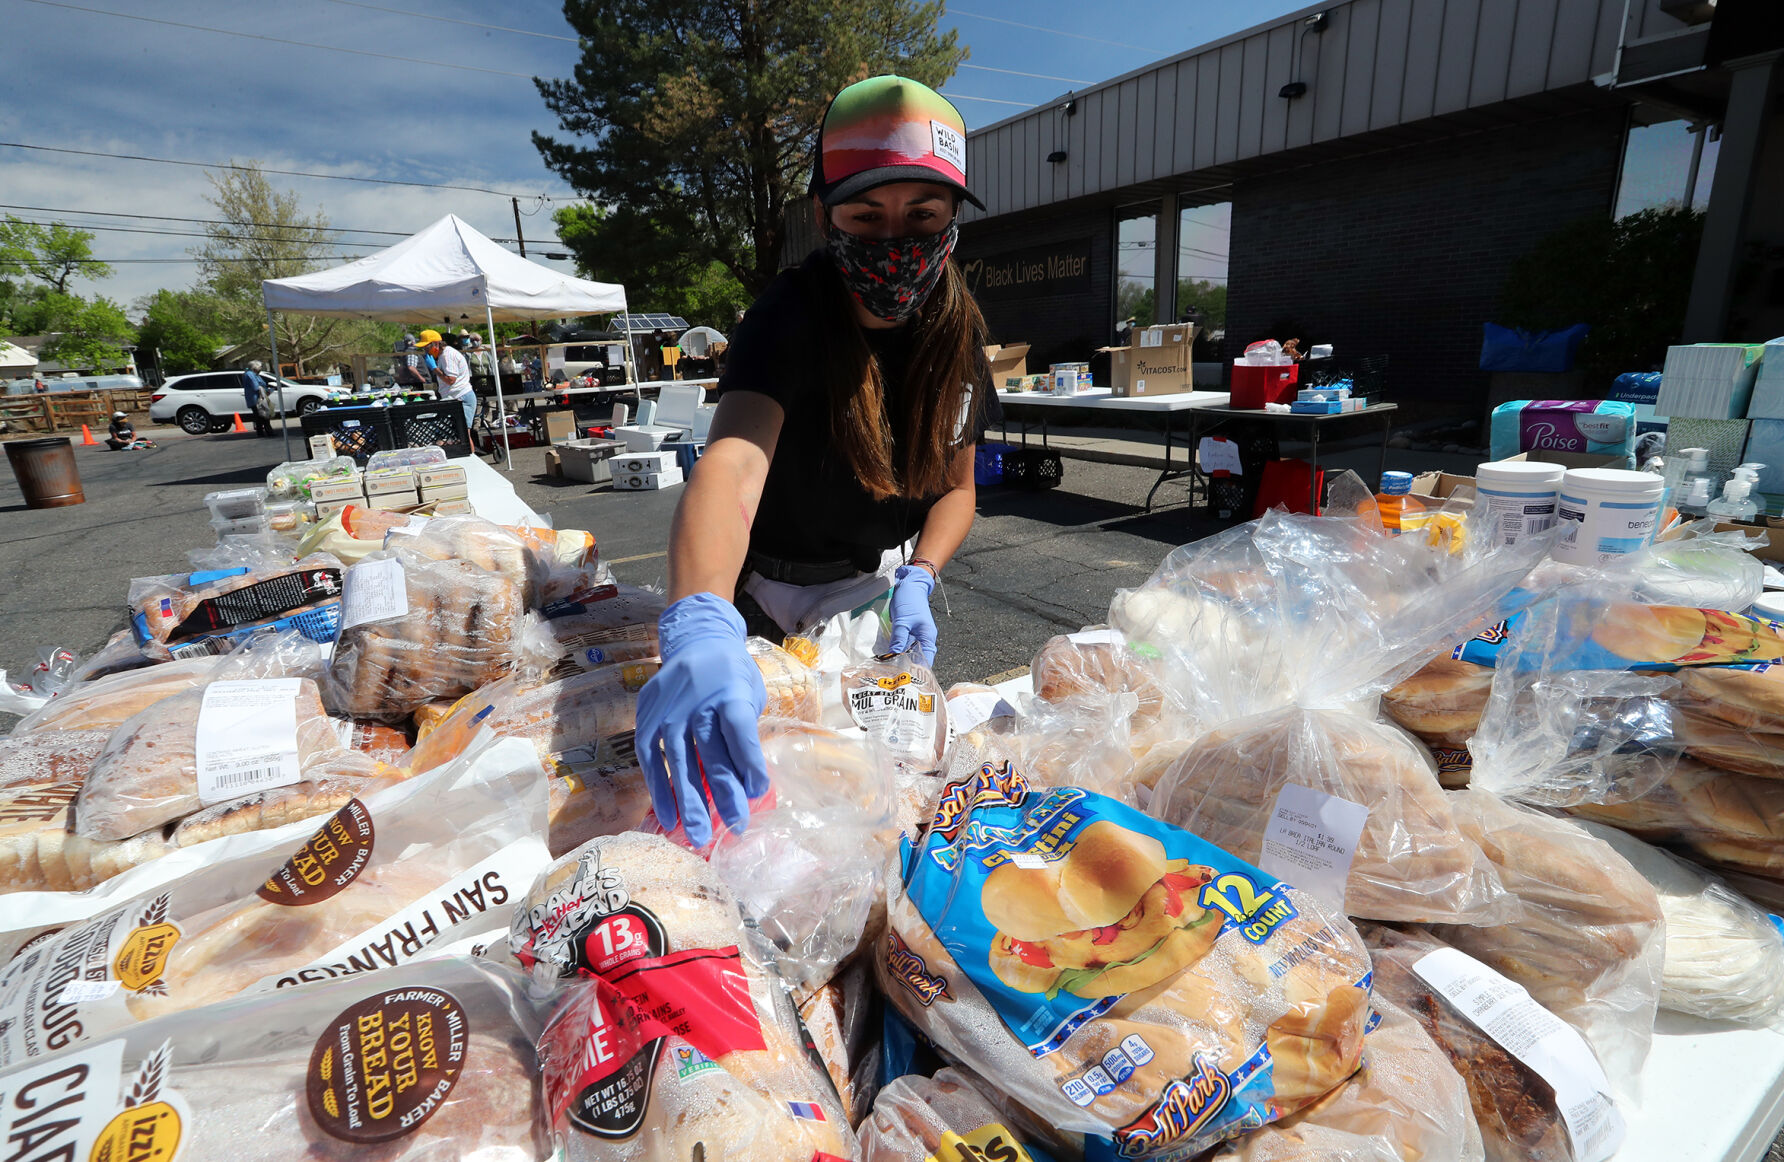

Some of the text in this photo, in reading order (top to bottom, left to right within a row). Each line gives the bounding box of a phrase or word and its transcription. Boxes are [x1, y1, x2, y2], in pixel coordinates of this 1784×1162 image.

[936, 126, 955, 143] WILD
[938, 137, 959, 156] BASIN
[985, 254, 1087, 288] Black Lives Matter
[1526, 422, 1578, 450] Poise
[328, 815, 354, 847] NOW
[334, 802, 372, 886] MILLER BAKER
[1327, 843, 1346, 855] ROUND
[441, 871, 510, 927] SAN
[533, 888, 630, 951] BREAD
[1203, 874, 1275, 924] 12
[1244, 899, 1294, 942] COUNT
[619, 948, 642, 963] GRAINS
[903, 954, 945, 997] Park
[42, 921, 103, 1051] SOURDOUG
[24, 1028, 40, 1058] CLAS
[384, 990, 465, 1128] FARMER MILLER BAKER
[388, 1011, 418, 1094] YOUR
[416, 1011, 439, 1069] KNOW
[339, 1023, 362, 1129] From Grain To Loaf
[358, 1010, 394, 1120] BREAD
[584, 1061, 644, 1110] NET WT 16.75 OZ
[681, 1062, 719, 1077] VERIFI
[591, 1104, 602, 1119] (1
[601, 1095, 619, 1114] LBS
[618, 1086, 635, 1104] 0.75
[1065, 1080, 1084, 1096] 210
[1168, 1054, 1227, 1130] Park
[614, 1105, 636, 1121] 475g
[128, 1112, 169, 1162] izzi
